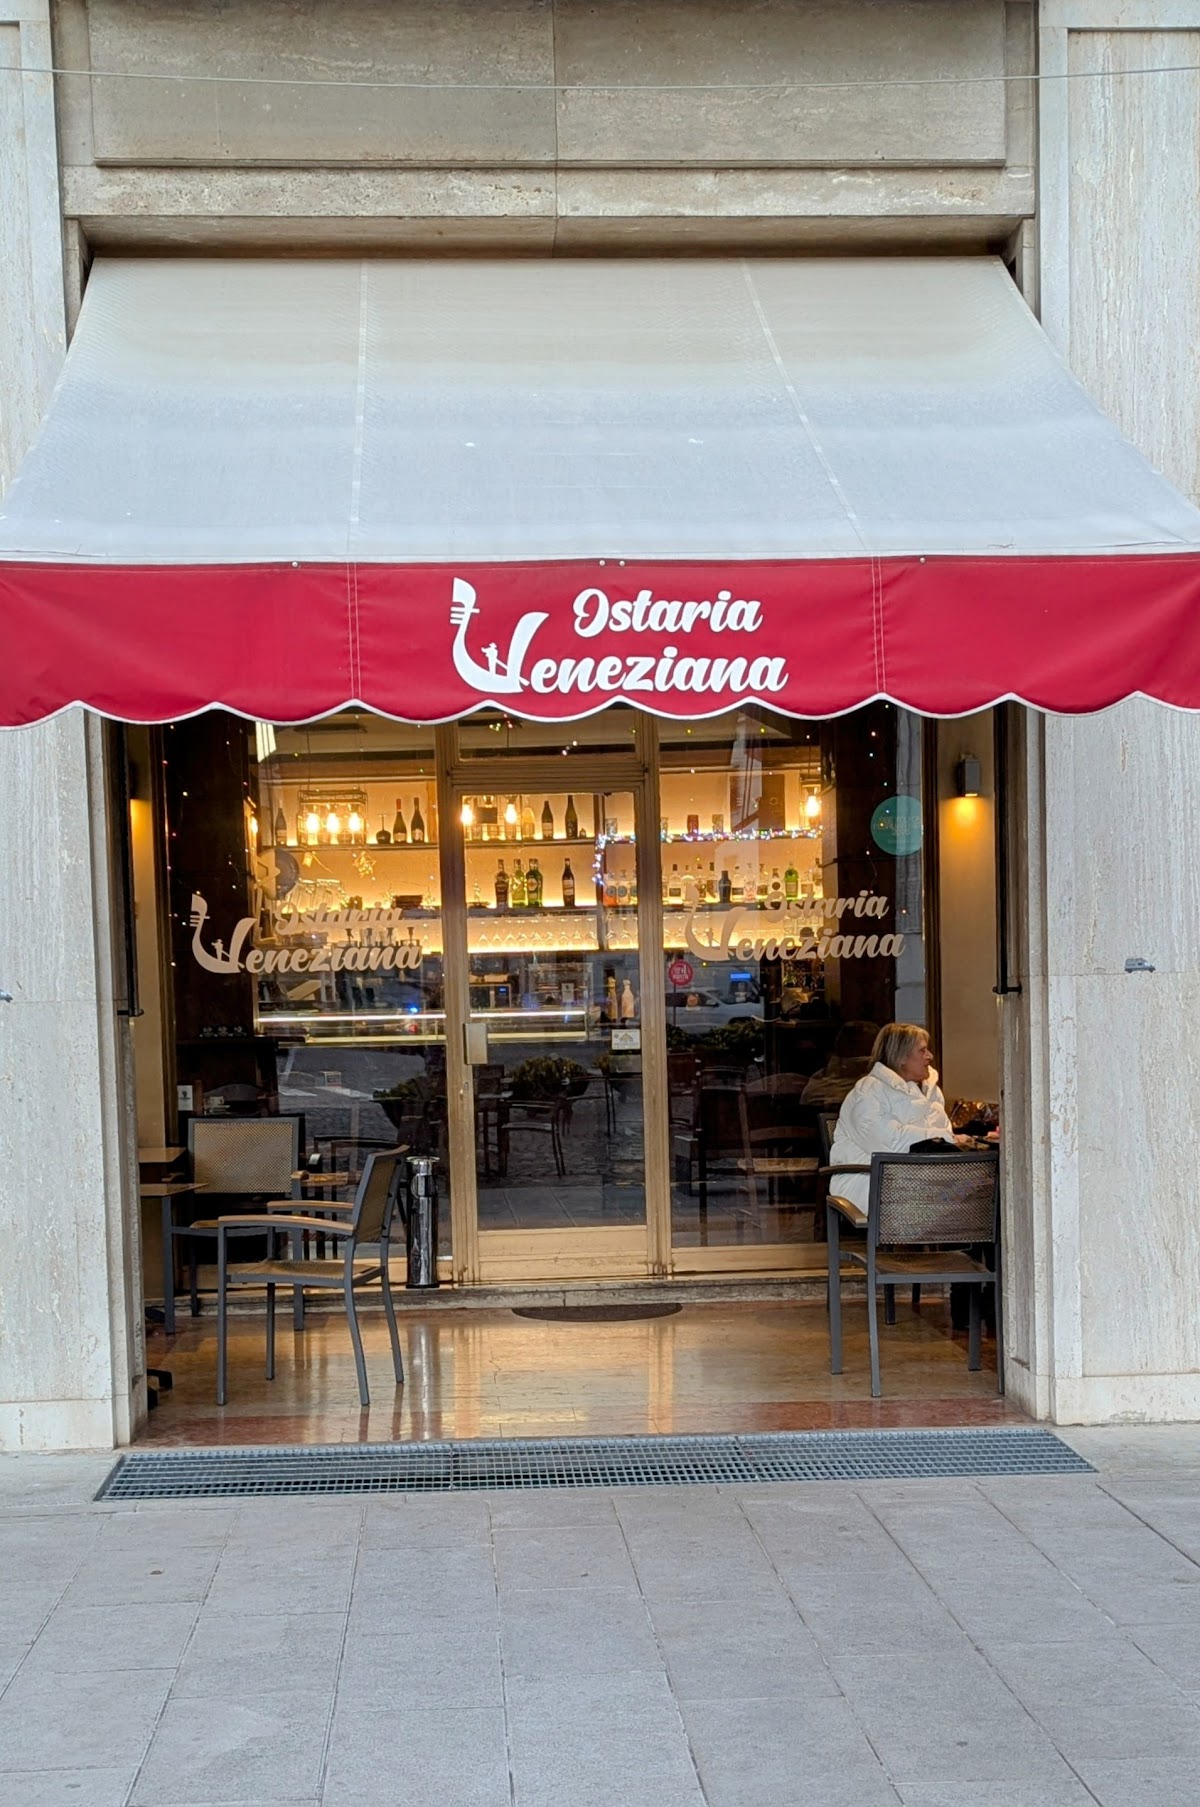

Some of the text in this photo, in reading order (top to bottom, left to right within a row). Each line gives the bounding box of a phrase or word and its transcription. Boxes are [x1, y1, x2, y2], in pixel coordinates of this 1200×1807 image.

[450, 577, 788, 693] Veneziana
[572, 588, 763, 637] Ostaria
[190, 893, 423, 974] Veneziana
[275, 901, 403, 935] Ostaria
[684, 883, 907, 962] Veneziana
[764, 890, 890, 923] Ostaria
